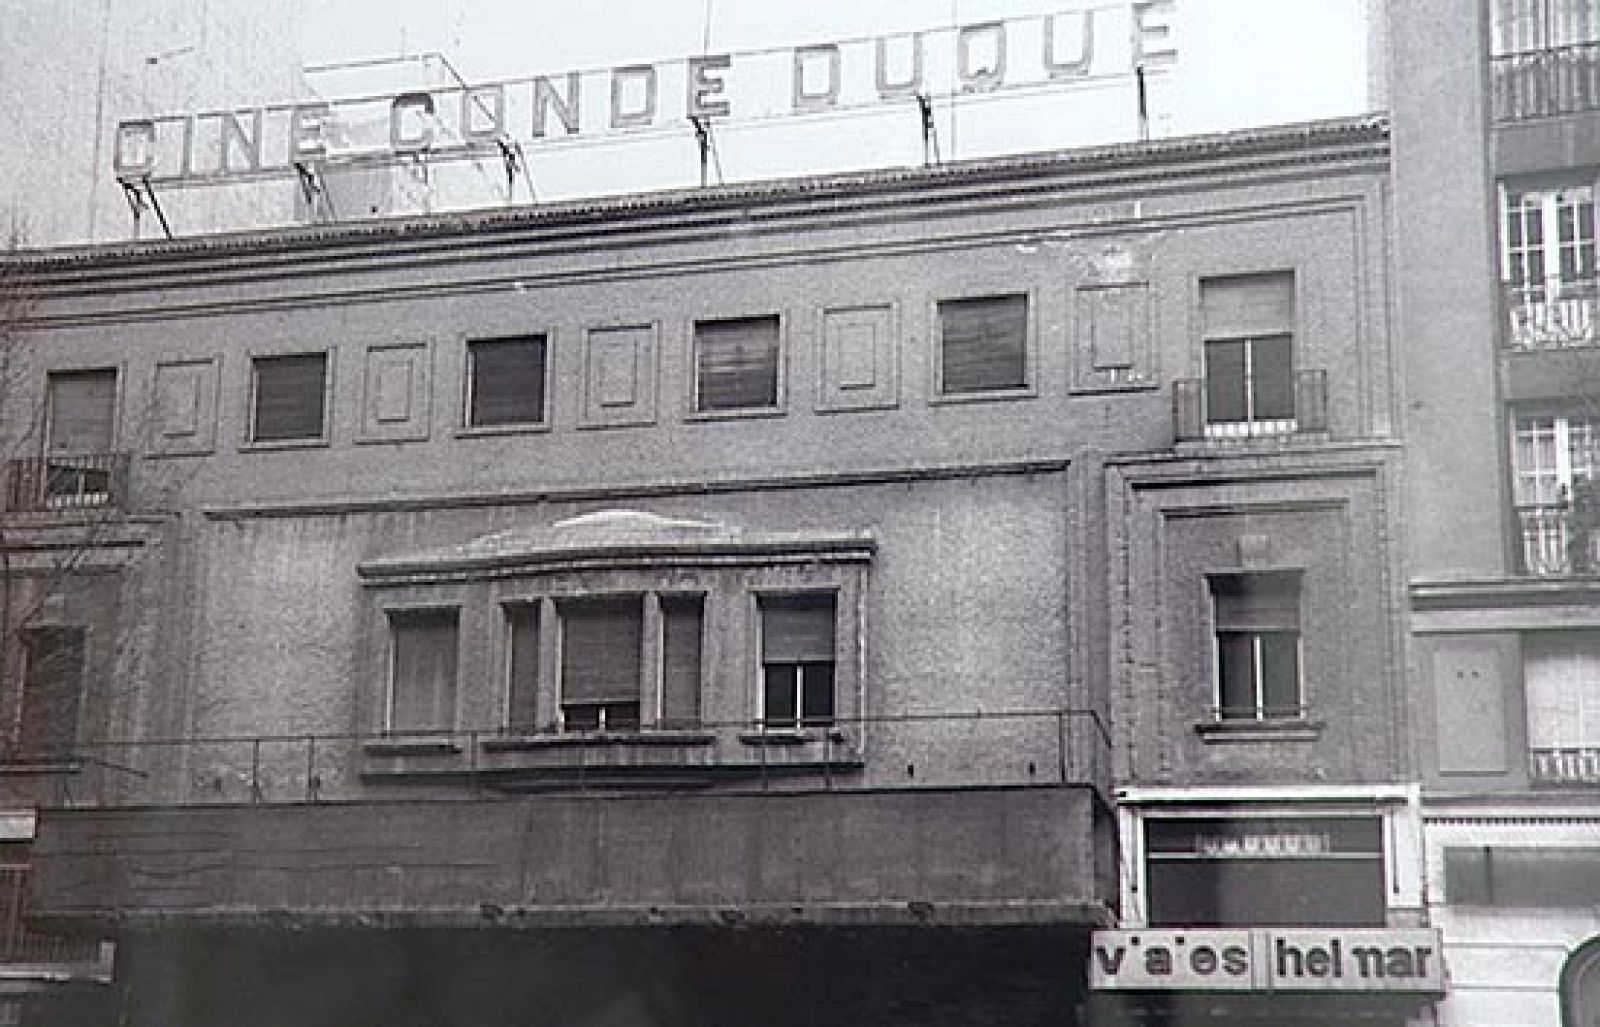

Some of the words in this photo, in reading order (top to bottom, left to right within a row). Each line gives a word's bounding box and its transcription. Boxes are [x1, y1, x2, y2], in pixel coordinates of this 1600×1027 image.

[115, 103, 330, 173] CINE
[390, 55, 731, 148] CONDE
[792, 1, 1178, 111] DUQUE
[1096, 936, 1249, 976] vaes
